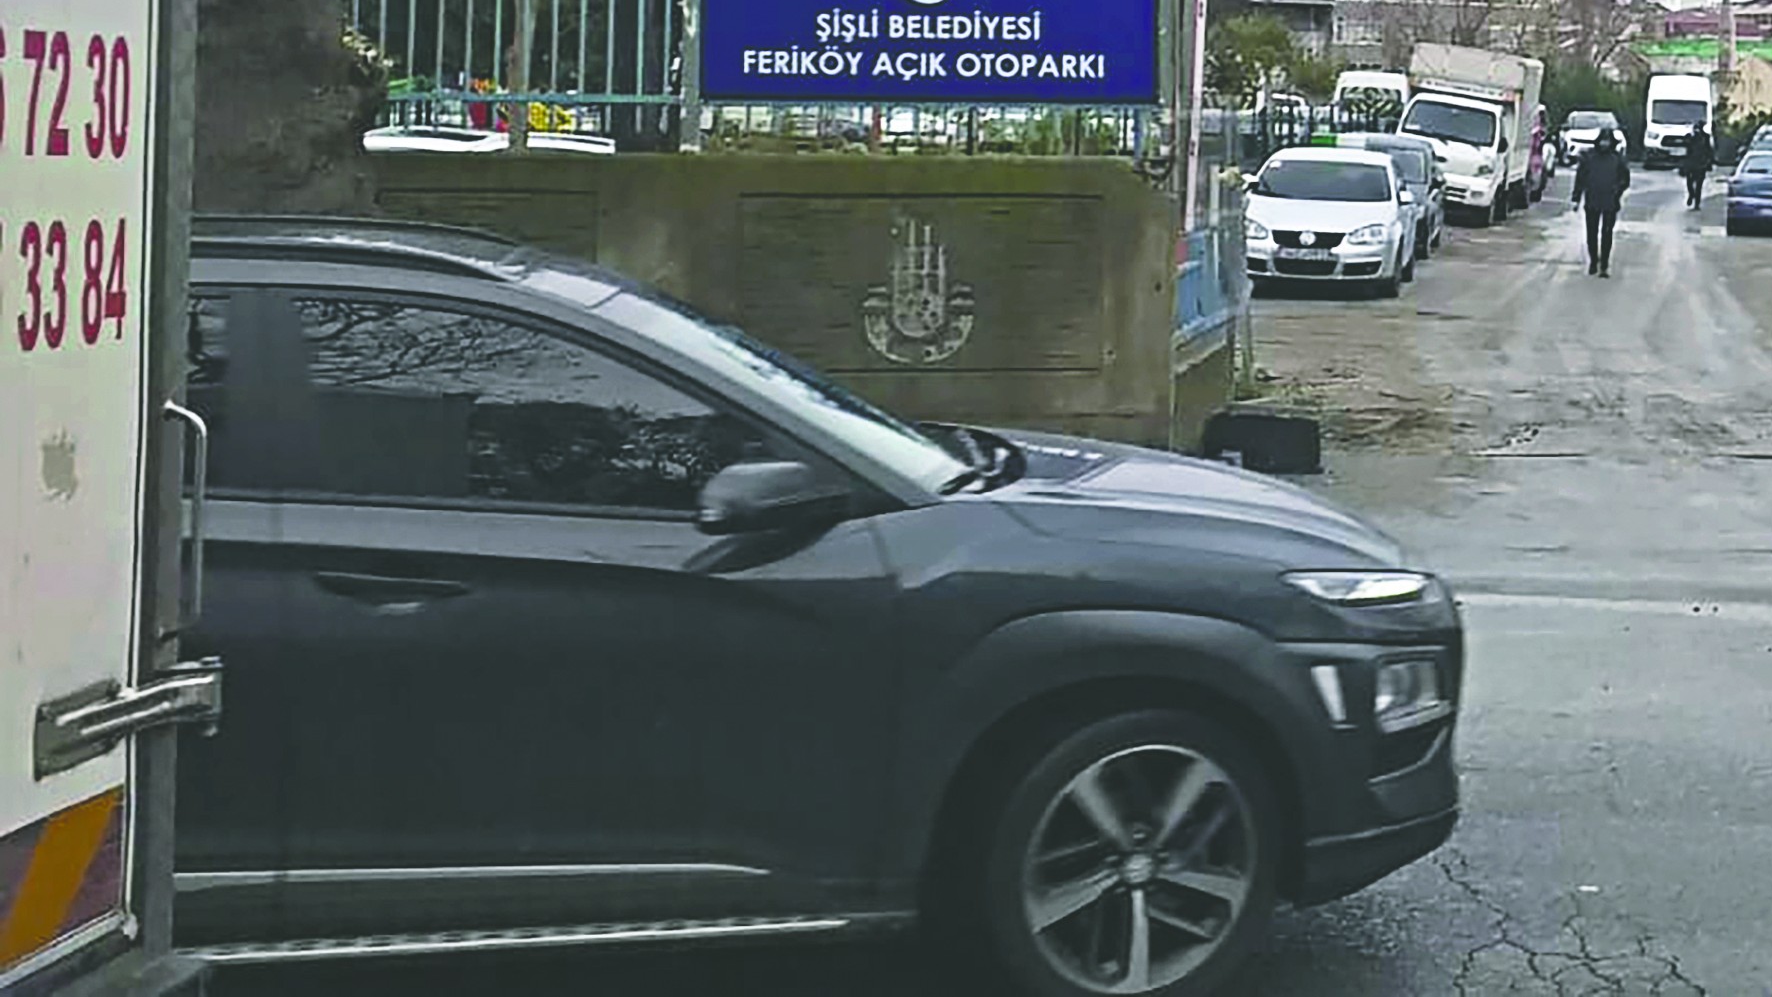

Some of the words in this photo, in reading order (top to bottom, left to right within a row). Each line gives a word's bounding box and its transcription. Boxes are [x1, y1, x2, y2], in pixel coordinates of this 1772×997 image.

[743, 45, 863, 75] FERİKÖY
[872, 52, 947, 81] AÇIK
[956, 53, 1104, 78] OTOPARKI
[816, 8, 878, 42] ŞİŞLİ
[889, 10, 1040, 41] BELEDİYESİ
[23, 29, 71, 156] 72
[85, 34, 129, 158] 30
[17, 220, 66, 351] 33
[82, 218, 126, 345] 84
